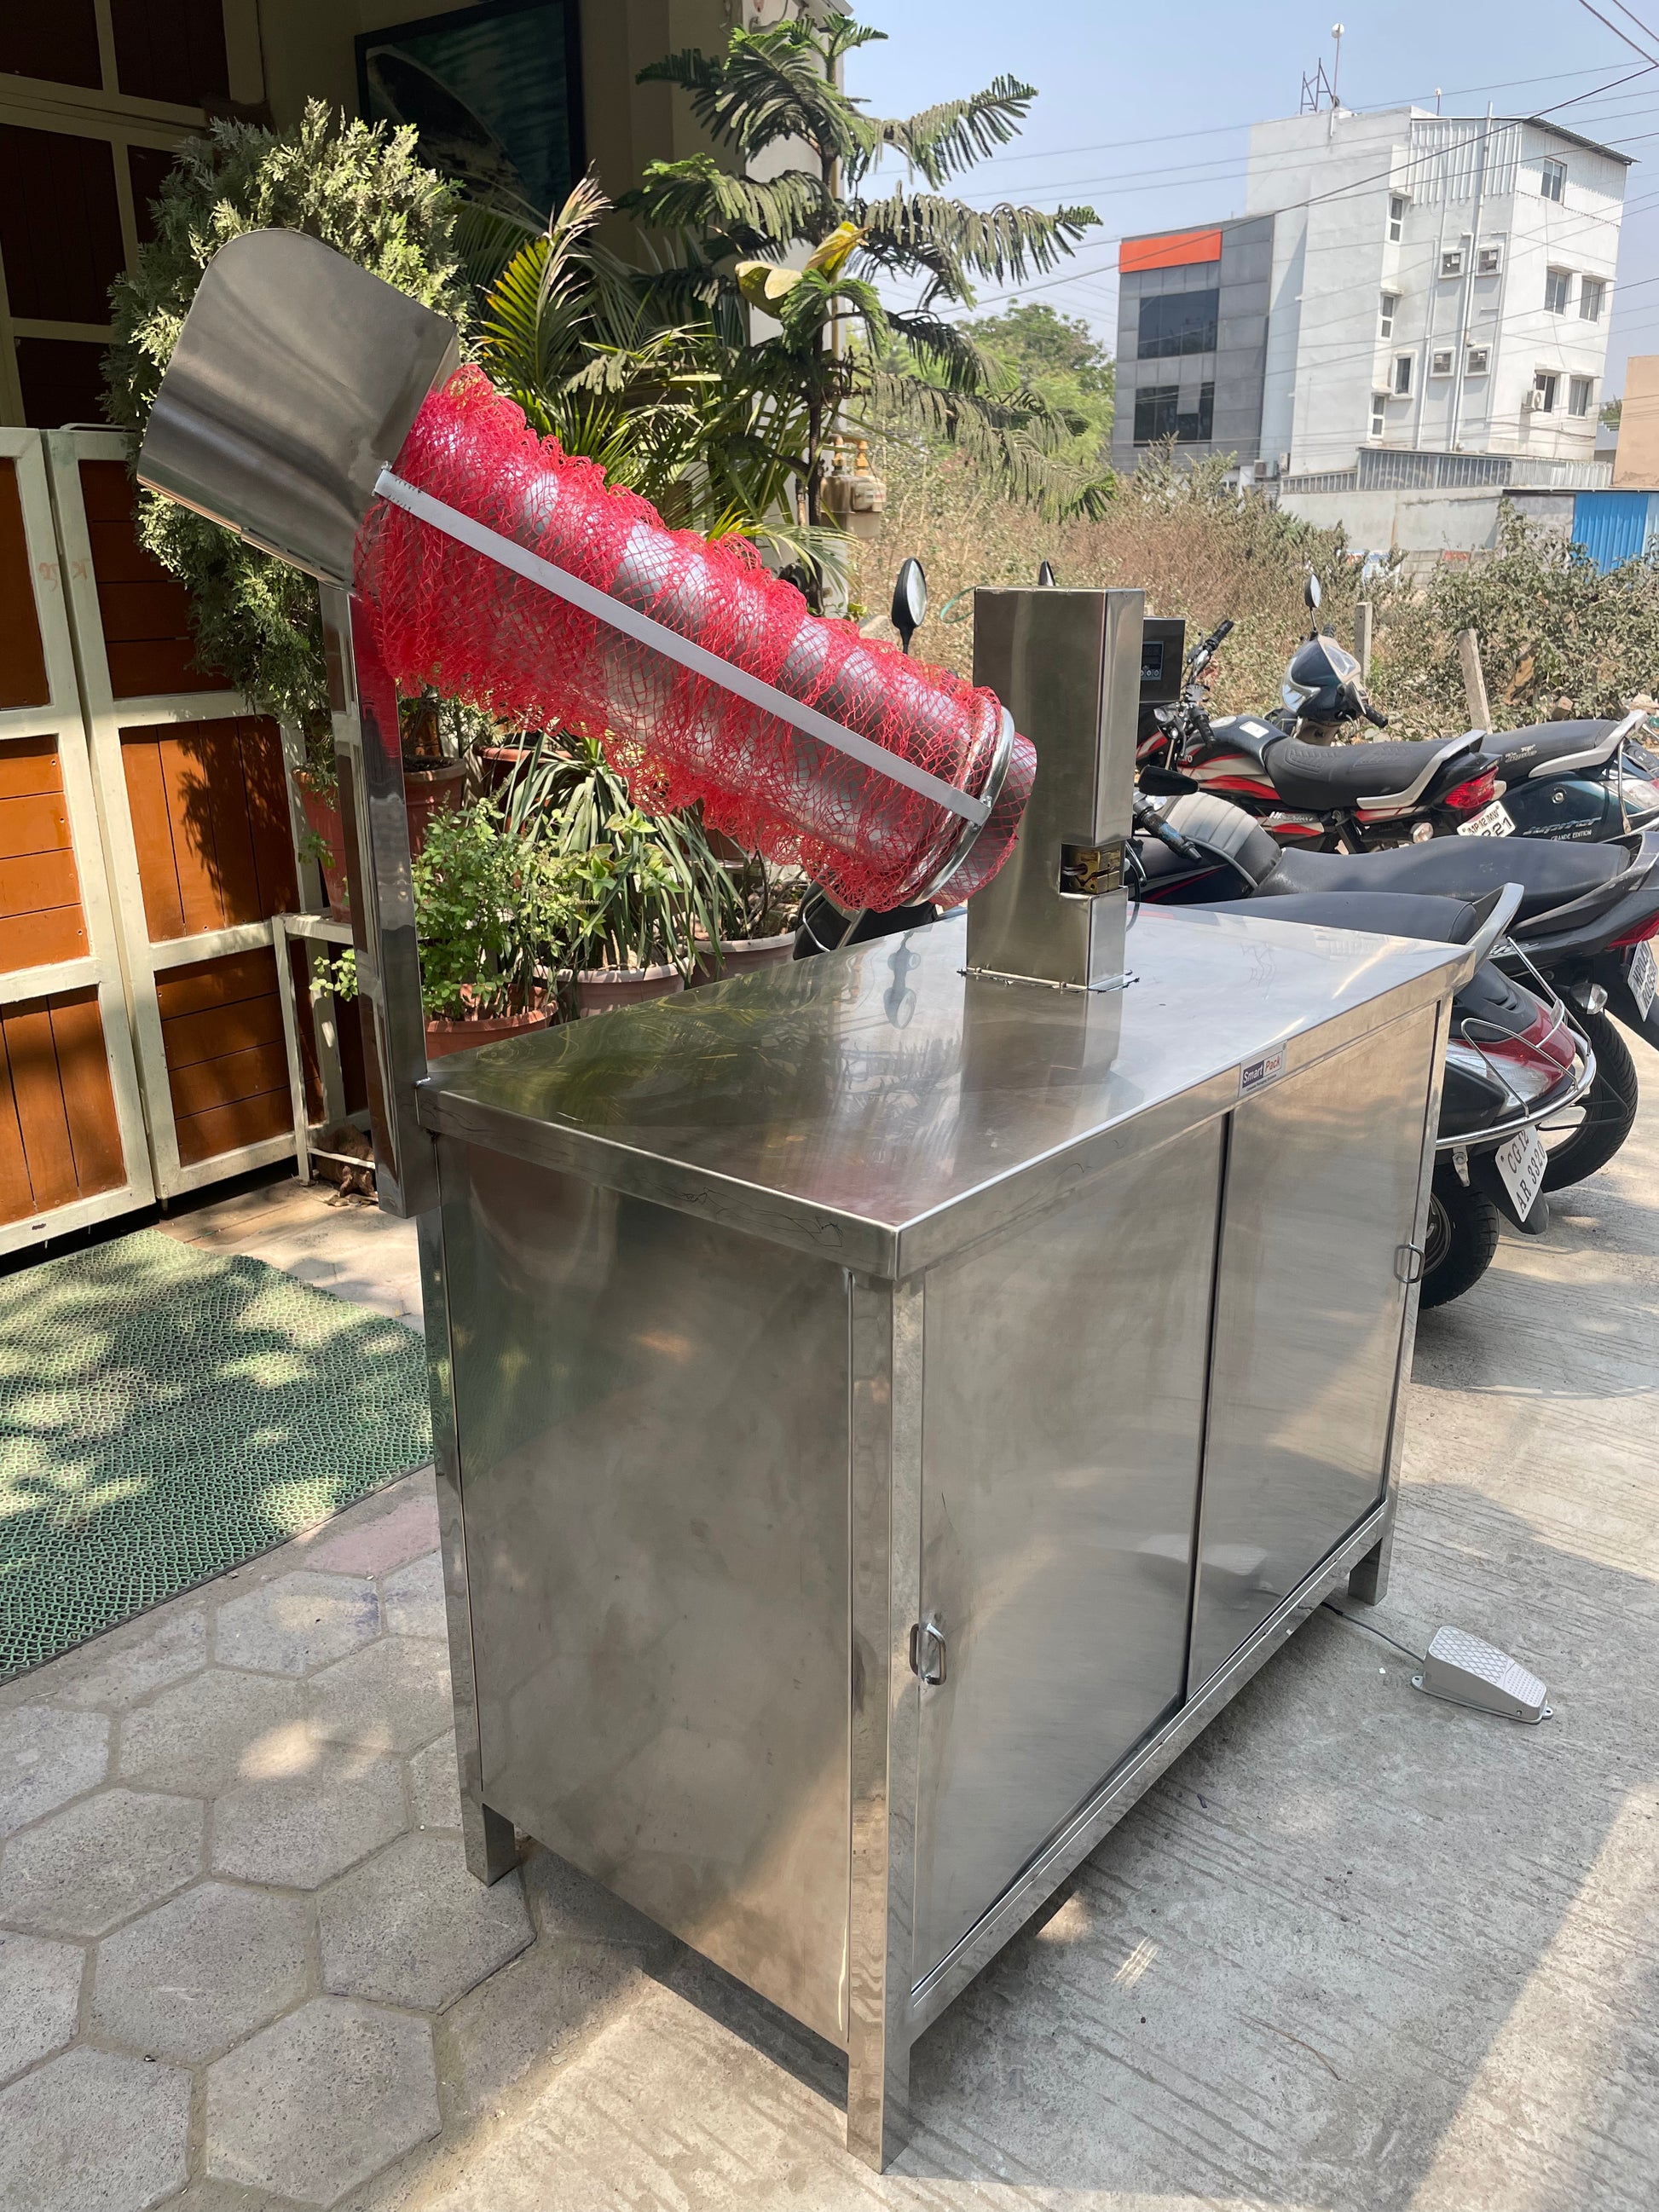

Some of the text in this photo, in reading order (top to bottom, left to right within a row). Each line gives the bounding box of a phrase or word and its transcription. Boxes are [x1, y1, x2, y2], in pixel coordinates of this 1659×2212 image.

[1243, 1063, 1263, 1083] Smart
[1265, 1055, 1281, 1073] Pack
[1516, 1140, 1546, 1214] AR 3320
